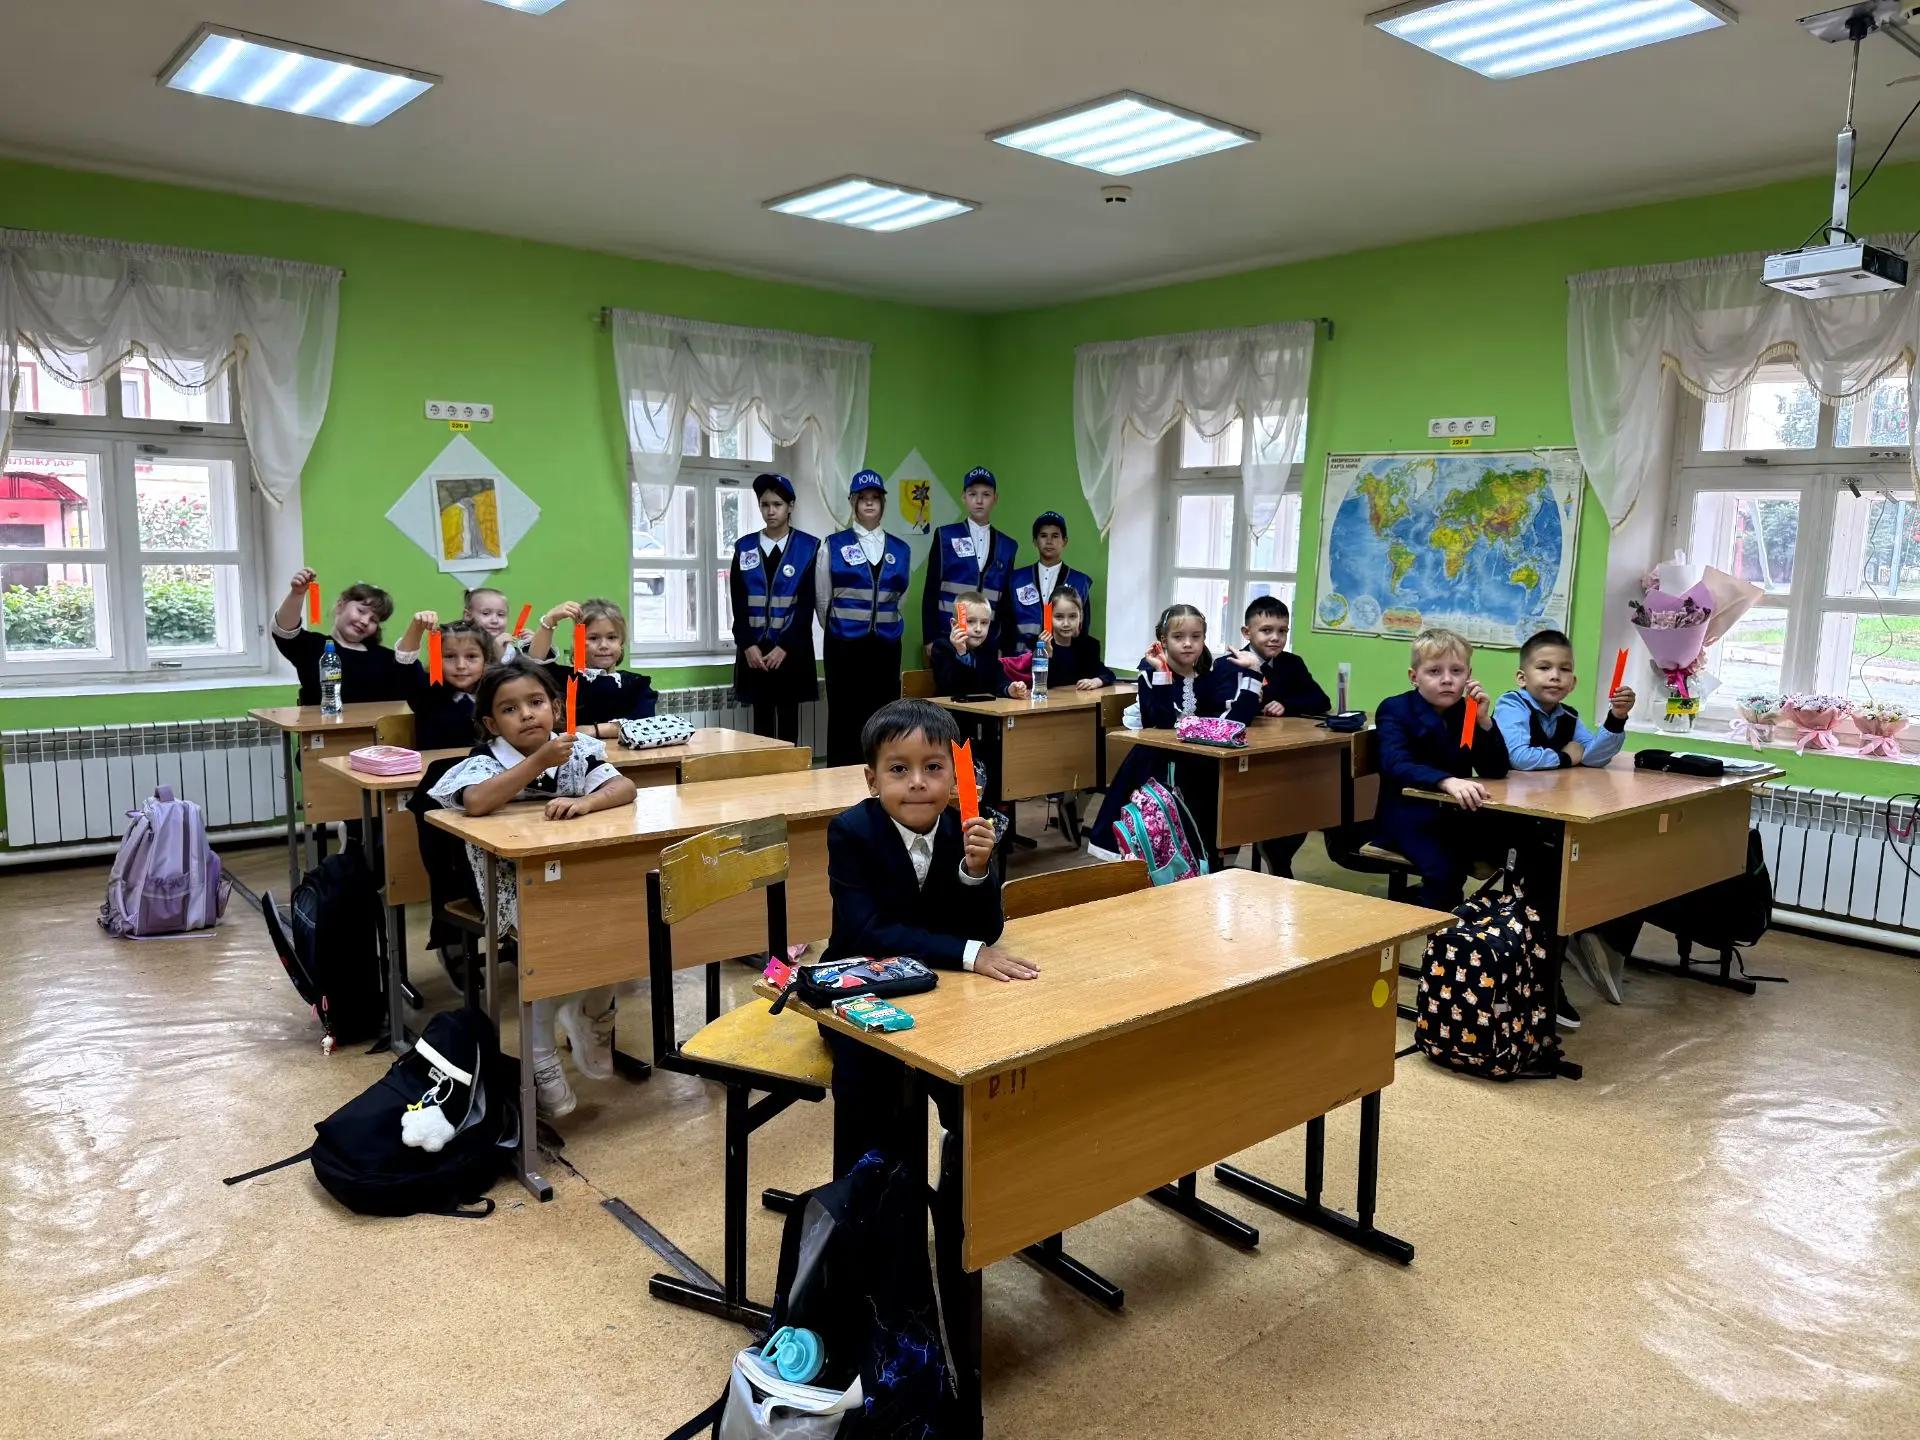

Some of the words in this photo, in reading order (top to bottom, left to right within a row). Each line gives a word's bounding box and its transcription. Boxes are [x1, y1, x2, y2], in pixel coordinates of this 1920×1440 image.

[858, 474, 881, 486] ЮИД
[549, 863, 556, 873] 4
[1384, 947, 1390, 960] 3
